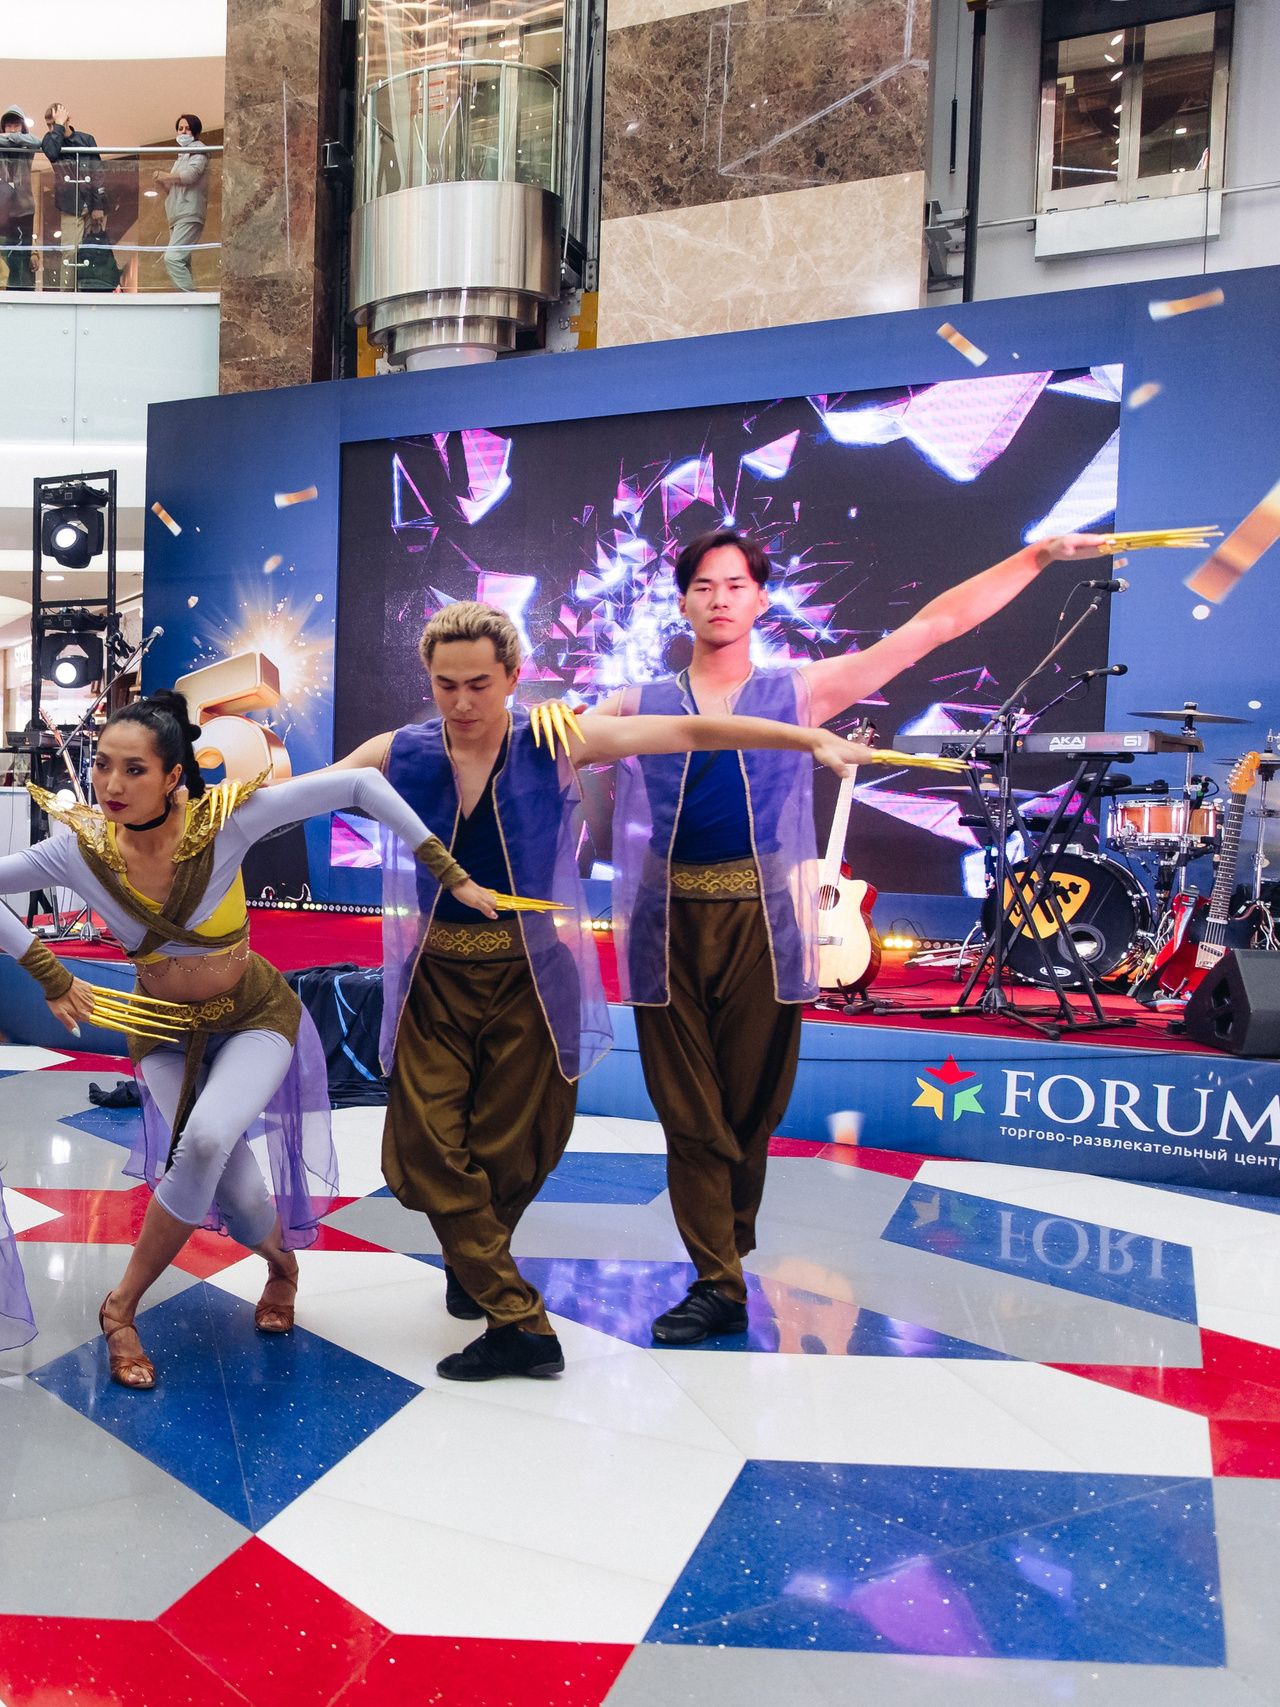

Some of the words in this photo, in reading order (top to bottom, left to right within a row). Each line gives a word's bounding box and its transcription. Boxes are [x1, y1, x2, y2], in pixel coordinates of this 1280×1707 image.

[1049, 735, 1087, 745] AKAI
[1000, 1068, 1280, 1147] FORUM
[999, 1125, 1228, 1162] торгово-развлекательный
[1234, 1151, 1280, 1172] цент
